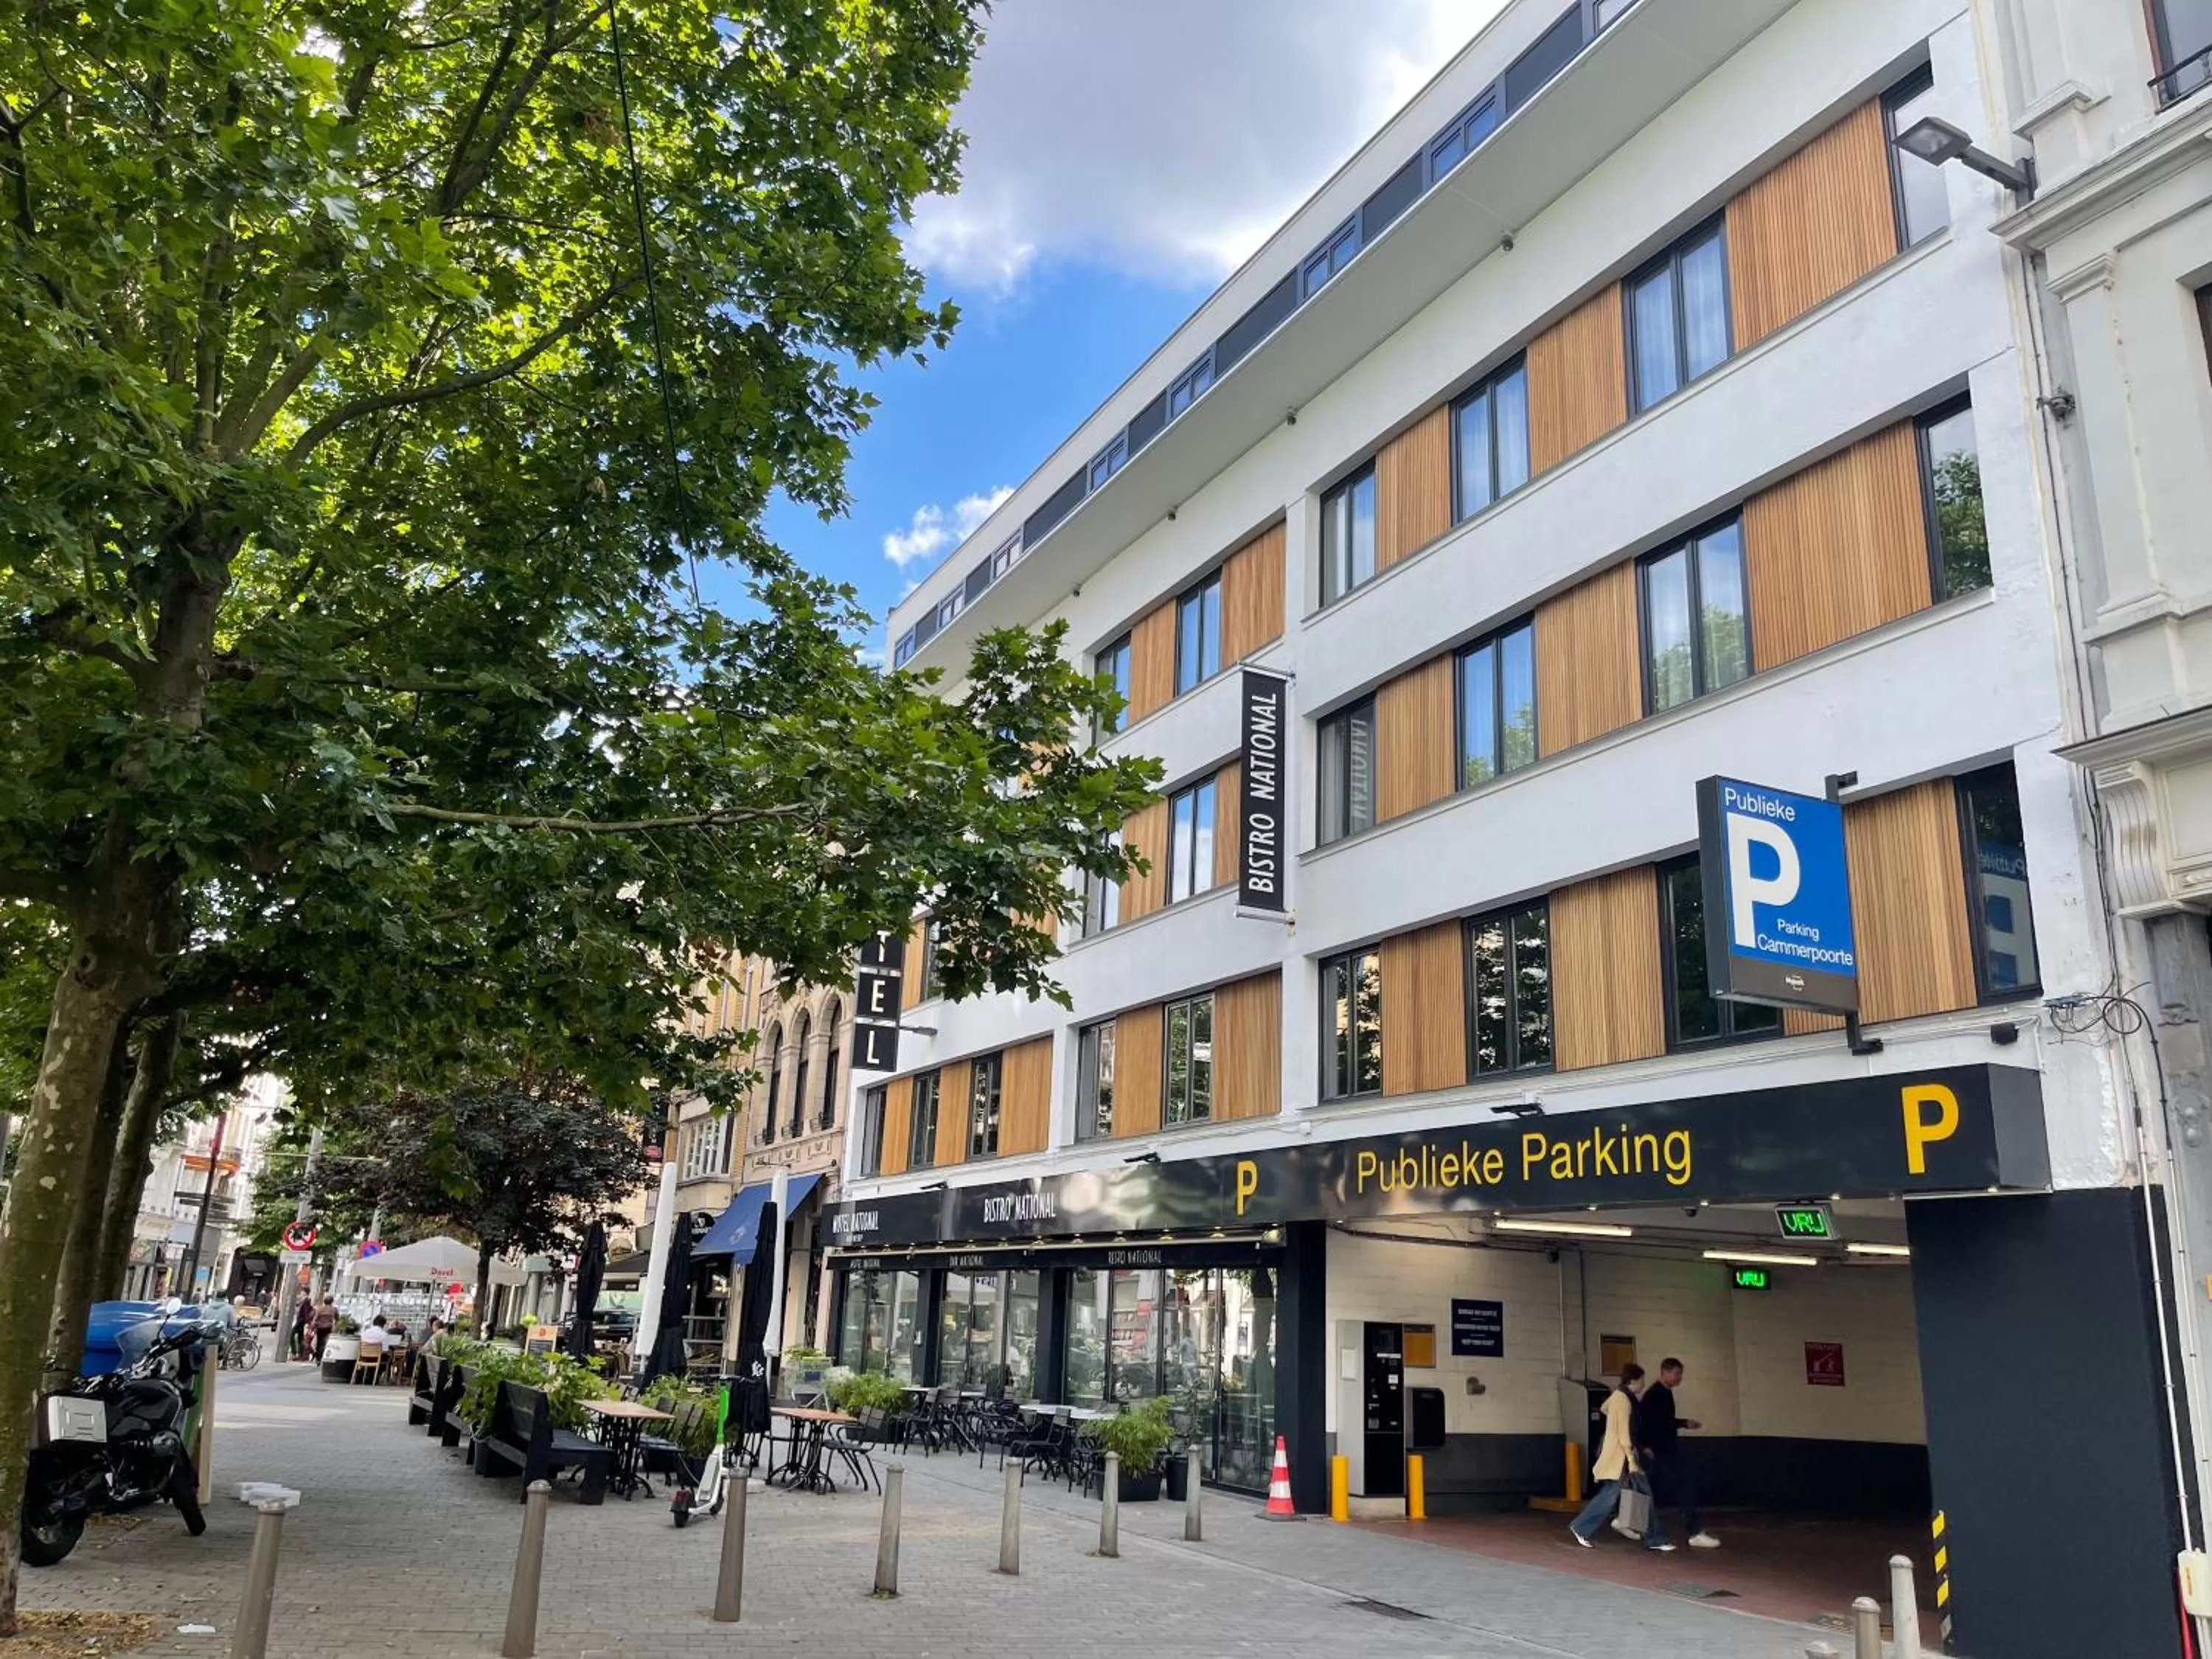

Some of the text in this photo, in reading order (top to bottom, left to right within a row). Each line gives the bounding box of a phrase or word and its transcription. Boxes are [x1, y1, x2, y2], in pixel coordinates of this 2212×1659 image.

[1248, 692, 1277, 893] BISTRO NATIONAL
[1724, 786, 1796, 822] Publieke
[1725, 812, 1801, 948] P
[1757, 933, 1854, 966] Cammerpoorte
[1776, 918, 1820, 942] Parking
[1901, 1083, 1959, 1175] P
[1356, 1123, 1692, 1194] Publieke Parking
[983, 1192, 1057, 1223] BISTRO NATIONAL
[1235, 1160, 1258, 1216] P
